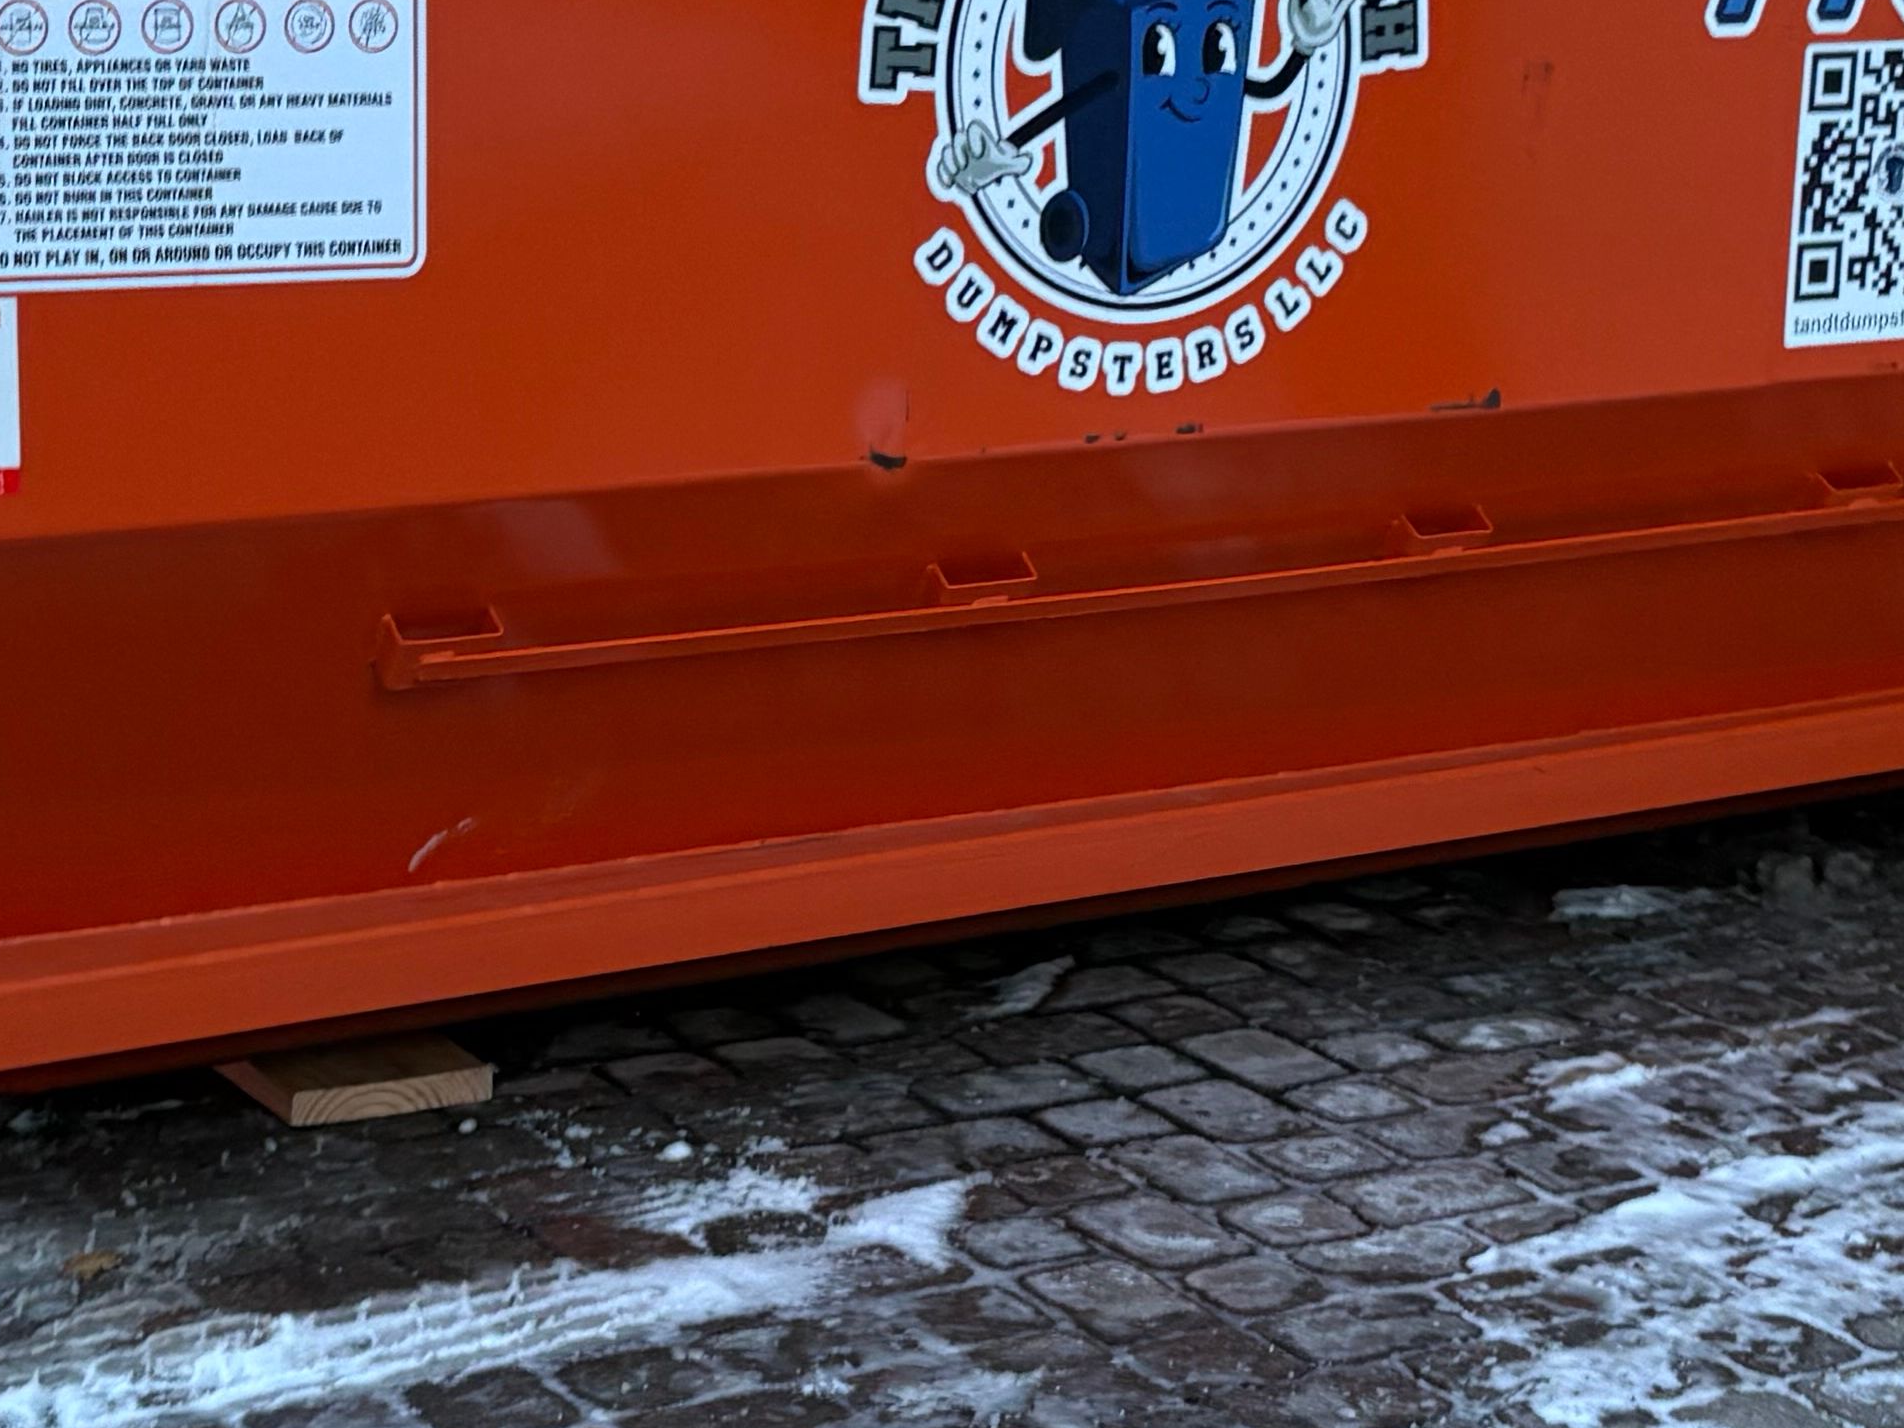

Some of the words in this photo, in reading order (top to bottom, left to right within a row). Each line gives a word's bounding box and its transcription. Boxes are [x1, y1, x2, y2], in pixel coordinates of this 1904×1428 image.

[12, 60, 29, 73] NO
[76, 58, 151, 73] APPLIANCES
[154, 58, 171, 73] OR
[175, 58, 206, 72] YARD
[209, 57, 250, 72] WASTE
[12, 79, 29, 93] DO
[32, 78, 56, 93] NOT
[60, 78, 85, 92] FILL
[89, 78, 121, 93] OVER
[126, 77, 146, 92] THE
[152, 77, 175, 91] TOP
[179, 77, 194, 91] OF
[197, 76, 264, 91] CONTAINER
[12, 97, 24, 112] IF
[28, 97, 80, 112] LOADING
[191, 94, 235, 109] GRAVEL
[239, 94, 256, 109] OR
[258, 93, 283, 109] ANY
[286, 93, 325, 109] HEAVY
[327, 91, 392, 108] MATERIALS
[12, 117, 36, 132] FILL
[41, 116, 108, 131] CONTAINER
[112, 115, 142, 129] HALF
[147, 115, 175, 129] FULL
[178, 113, 208, 128] ONLY
[14, 135, 30, 150] DO
[34, 134, 58, 149] NOT
[62, 134, 101, 149] FORCE
[106, 133, 128, 148] THE
[132, 133, 164, 148] BACK
[169, 132, 200, 147] DOOR
[257, 129, 288, 144] LOAD
[294, 129, 326, 144] BACK
[329, 129, 345, 144] OF
[13, 153, 81, 169] CONTAINER
[85, 152, 124, 167] AFTER
[127, 151, 160, 166] DOOR
[163, 151, 175, 165] IS
[178, 150, 224, 165] CLOSED
[14, 172, 31, 188] DO
[35, 172, 59, 187] NOT
[63, 171, 102, 187] BLOCK
[106, 170, 152, 185] ACCESS
[157, 169, 172, 184] TO
[175, 167, 241, 184] CONTAINER
[15, 191, 32, 207] DO
[35, 190, 59, 206] NOT
[63, 190, 96, 205] BURN
[100, 189, 112, 204] IN
[116, 188, 143, 203] THIS
[146, 186, 213, 202] CONTAINER
[15, 209, 63, 225] HAULER
[66, 208, 77, 223] IS
[81, 207, 105, 223] NOT
[109, 205, 189, 223] RESPONSIBLE
[192, 203, 216, 219] FOR
[220, 203, 244, 219] ANY
[247, 201, 296, 218] DAMAGE
[300, 201, 337, 217] CAUSE
[341, 200, 363, 216] DUE
[367, 199, 382, 215] TO
[14, 228, 37, 244] THE
[41, 226, 114, 243] PLACEMENT
[118, 225, 134, 240] OF
[139, 224, 165, 240] THIS
[168, 222, 234, 239] CONTAINER
[13, 250, 41, 268] NOT
[45, 249, 81, 267] PLAY
[109, 247, 128, 264] ON
[132, 246, 151, 264] OR
[155, 244, 210, 263] AROUND
[214, 243, 233, 261] OR
[237, 241, 292, 260] OCCUPY
[296, 240, 325, 259] THIS
[329, 238, 402, 258] CONTAINER
[926, 240, 1256, 383] DUMPSTERS
[1276, 212, 1360, 319] LLC
